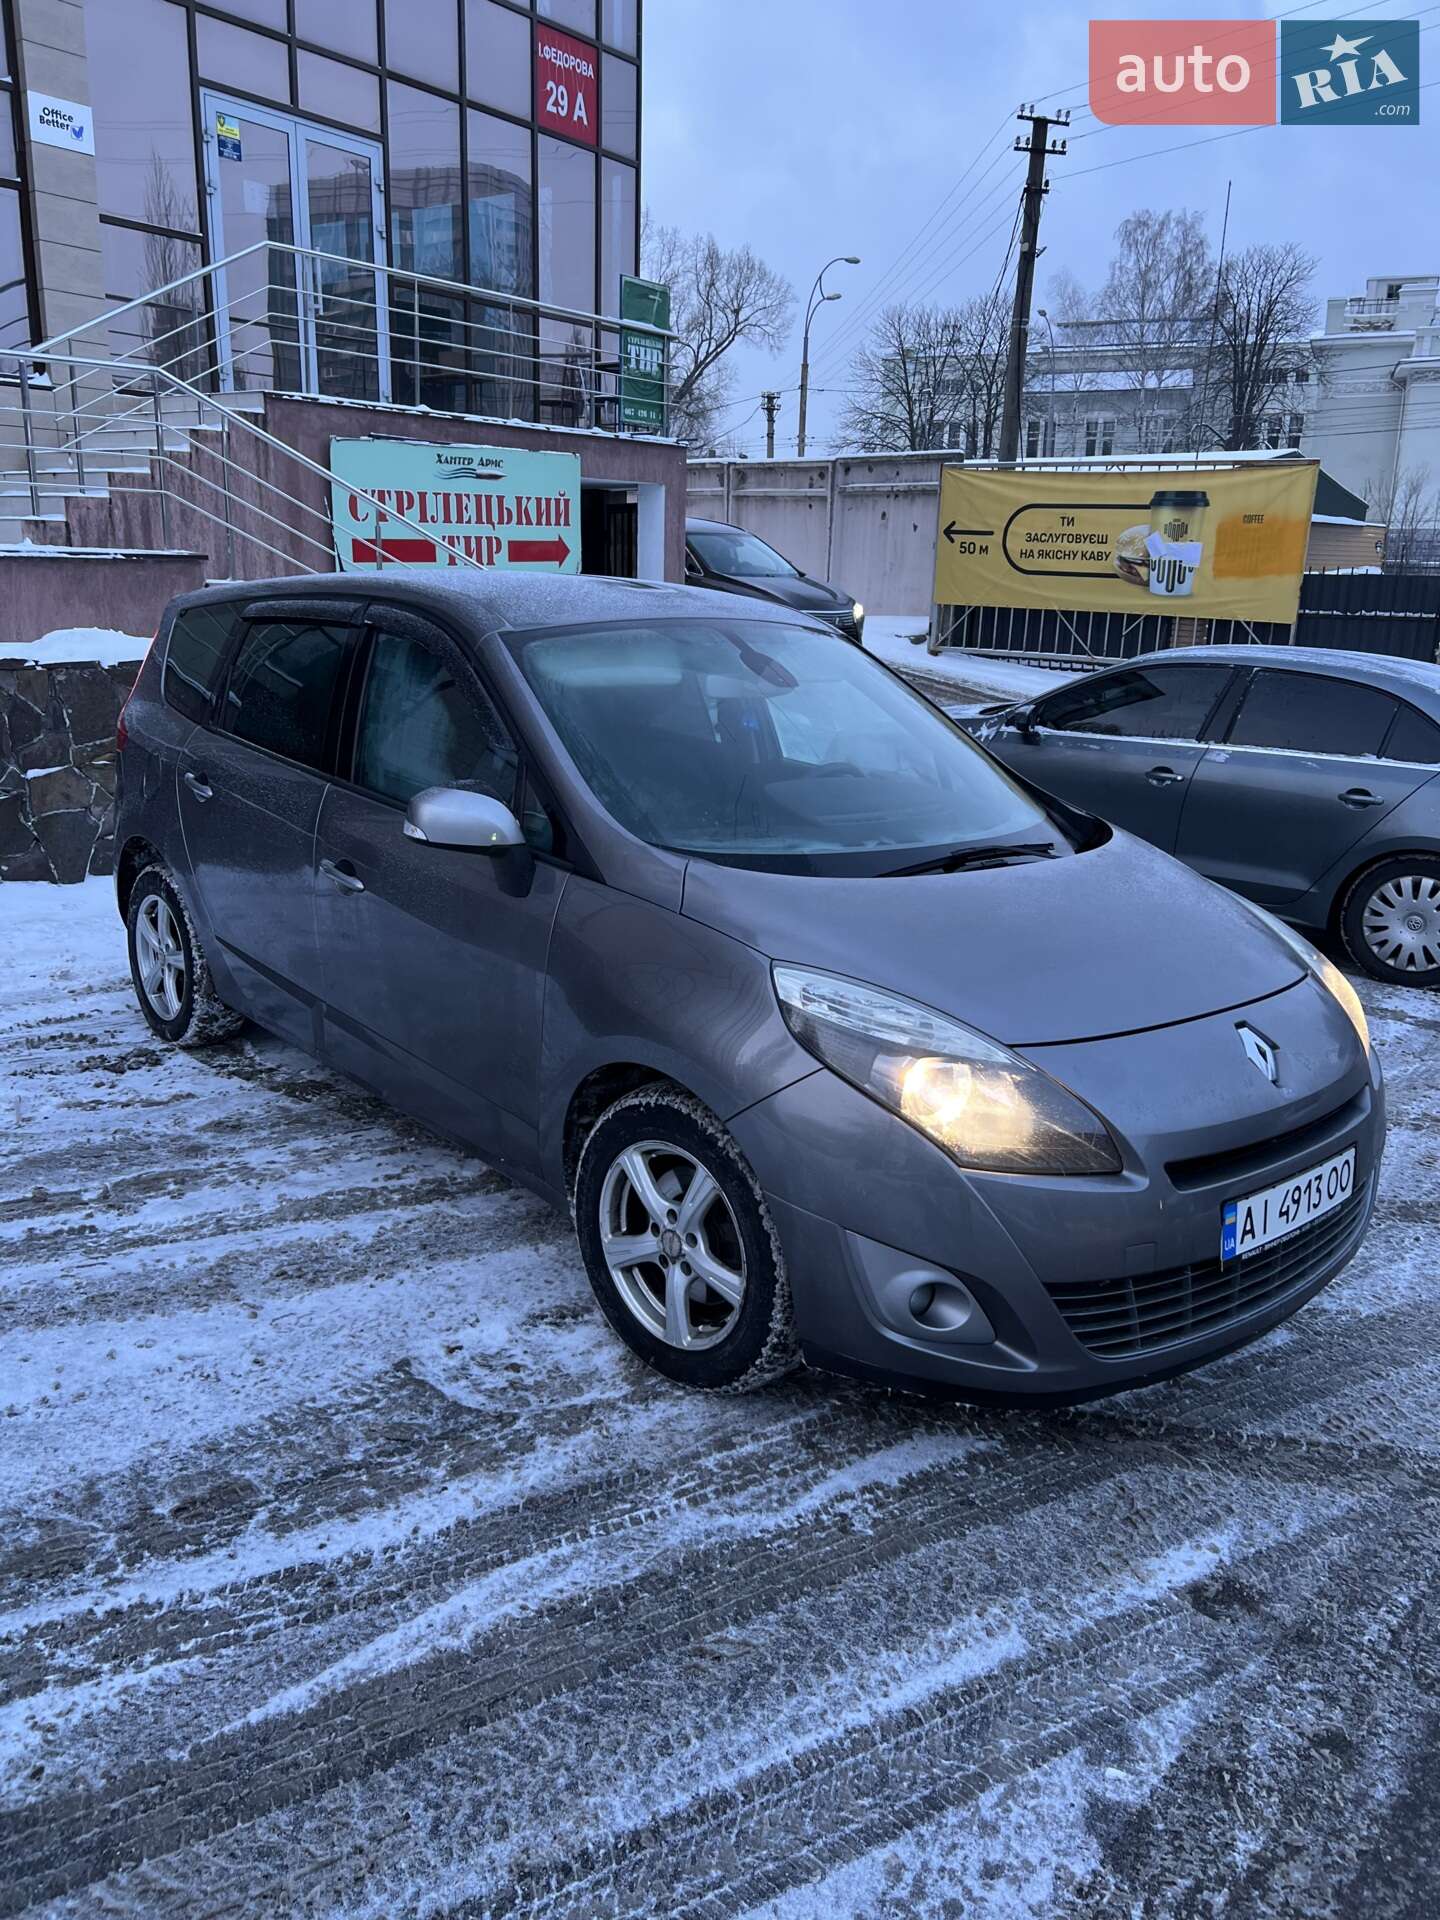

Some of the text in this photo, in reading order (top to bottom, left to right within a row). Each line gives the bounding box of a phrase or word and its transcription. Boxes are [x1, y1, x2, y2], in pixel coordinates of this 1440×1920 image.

[546, 80, 588, 127] 29 А
[42, 106, 74, 123] Office
[39, 114, 71, 131] Better
[1060, 516, 1075, 527] ТИ
[1025, 531, 1109, 545] ЗАСЛУГОВУЄШ
[442, 535, 503, 567] ТИР
[959, 541, 976, 555] 50
[1019, 549, 1111, 562] НА ЯКІСНУ КАВУ
[1240, 1199, 1268, 1245] AI
[1278, 1173, 1323, 1225] 4913
[1224, 1237, 1235, 1251] UA
